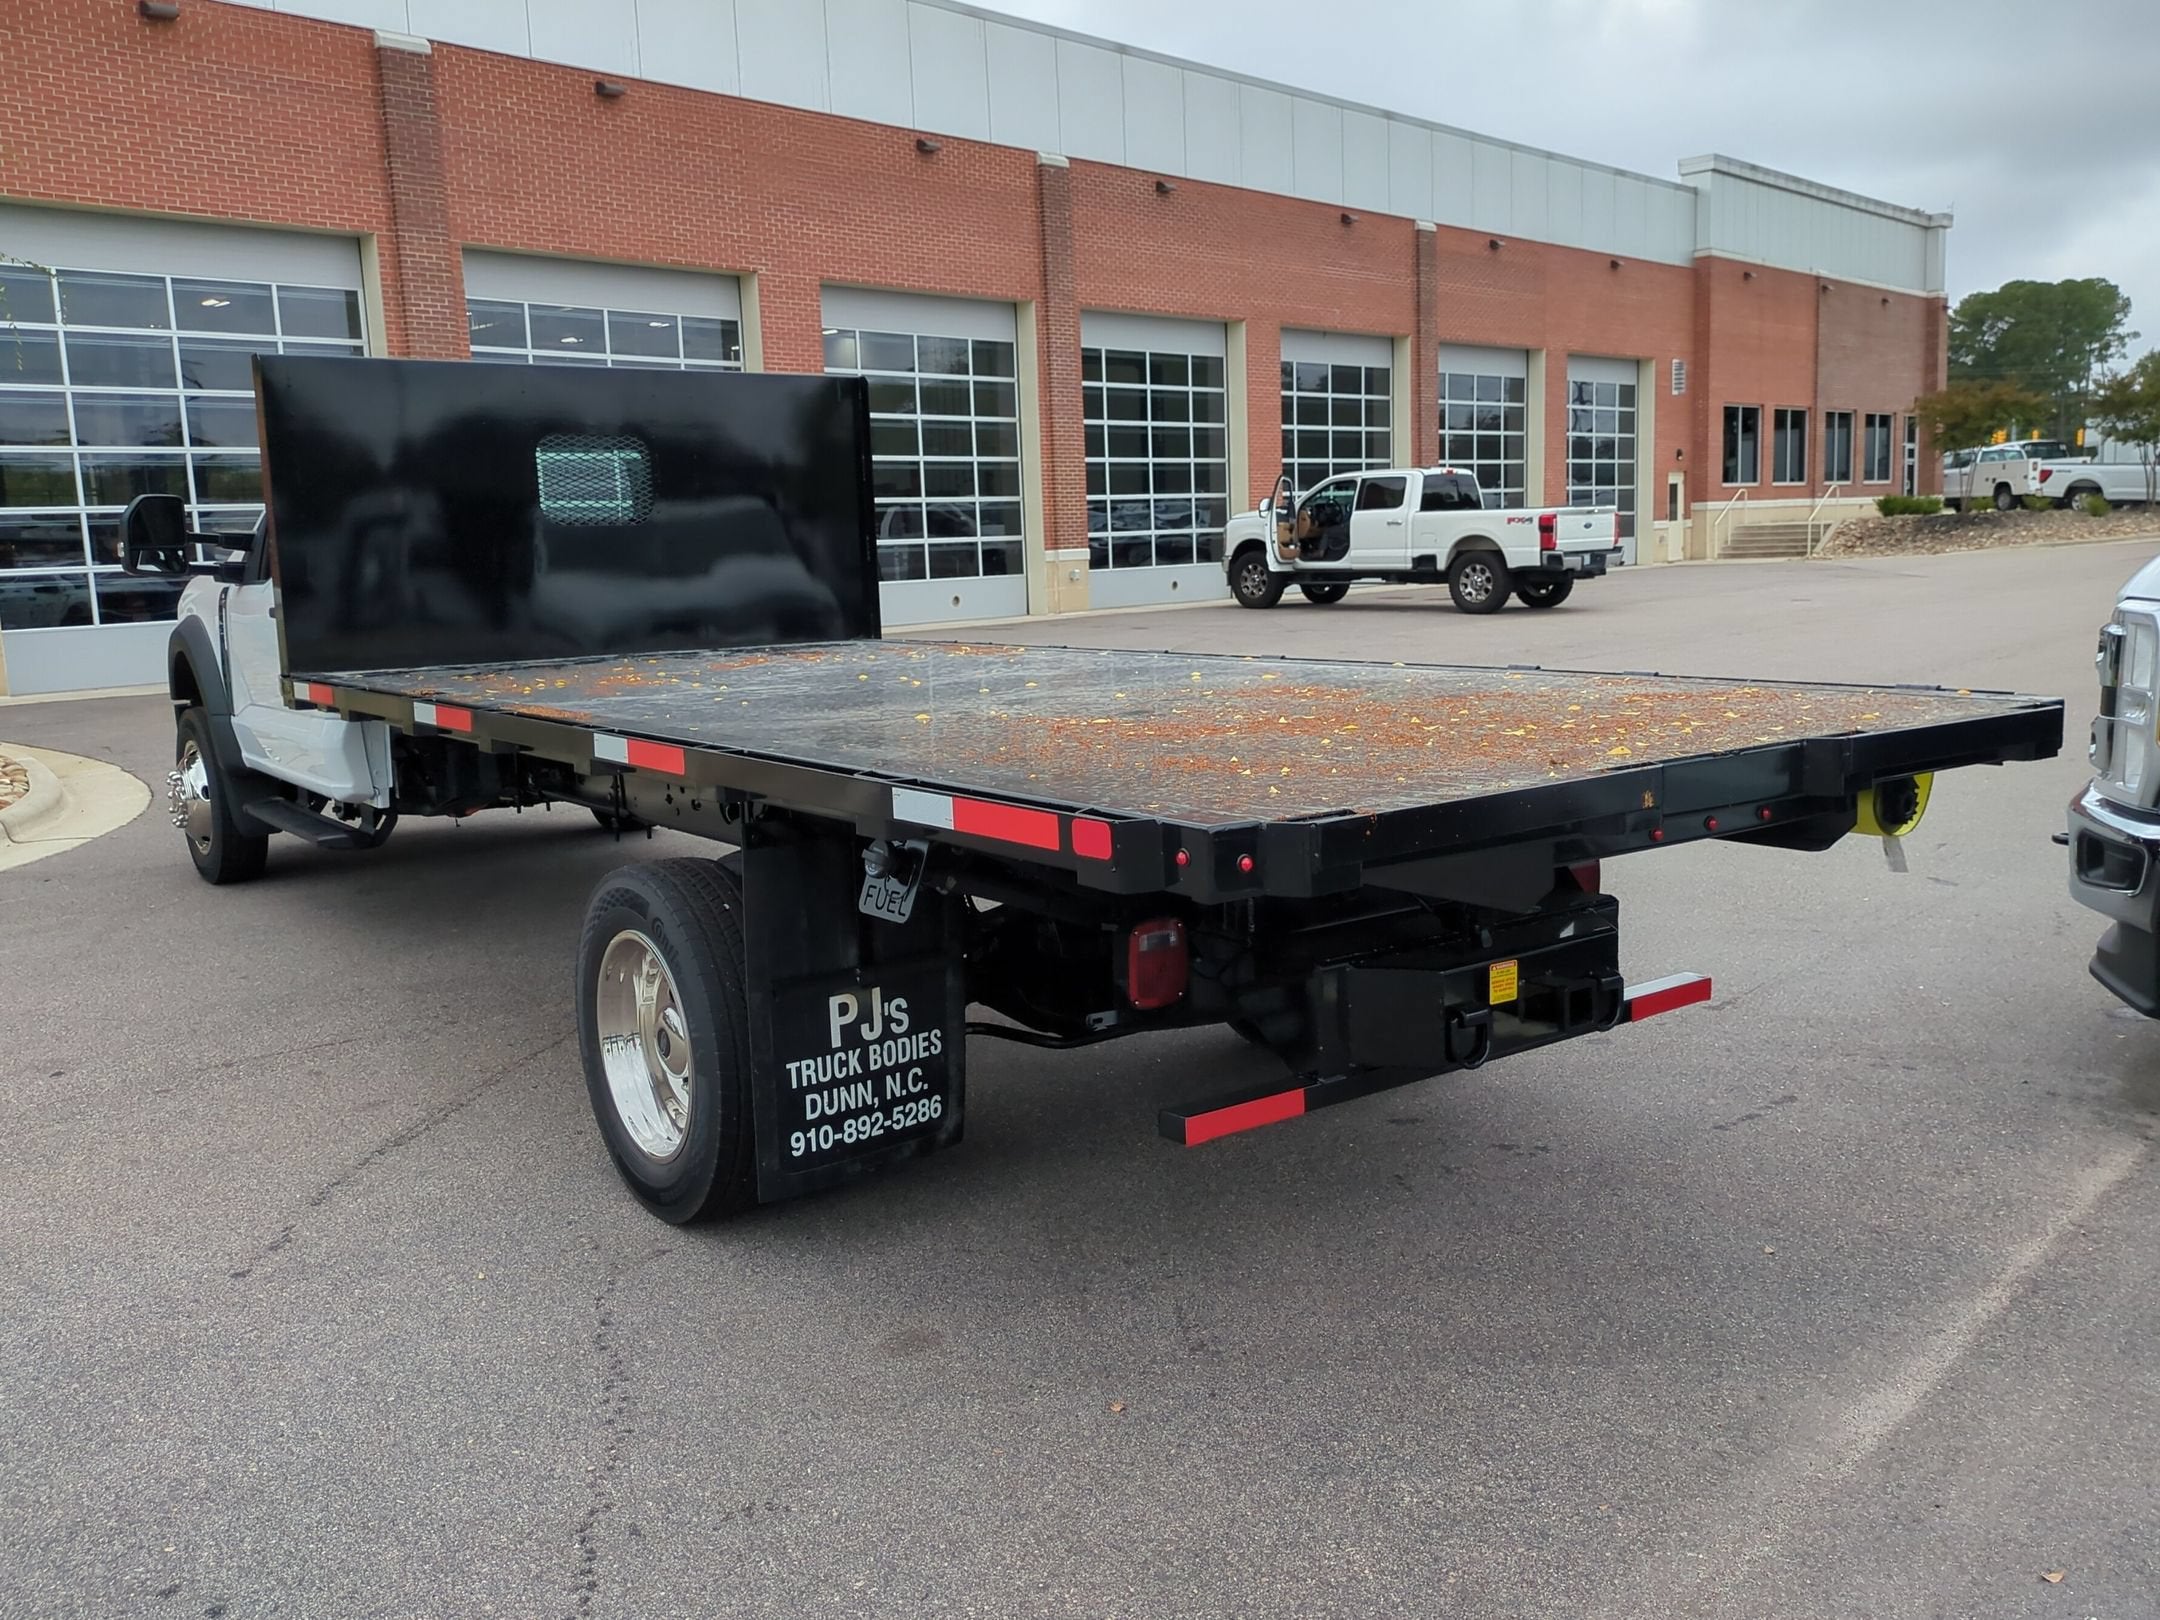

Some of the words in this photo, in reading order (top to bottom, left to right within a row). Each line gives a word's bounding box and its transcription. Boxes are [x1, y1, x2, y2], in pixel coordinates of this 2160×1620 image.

[863, 884, 906, 917] FUEL
[785, 1047, 863, 1090] TRUCK
[868, 1028, 942, 1072] BODIES
[805, 1080, 879, 1121] DUNN,
[886, 1067, 929, 1100] N.C.
[790, 1094, 942, 1157] 910-892-5286
